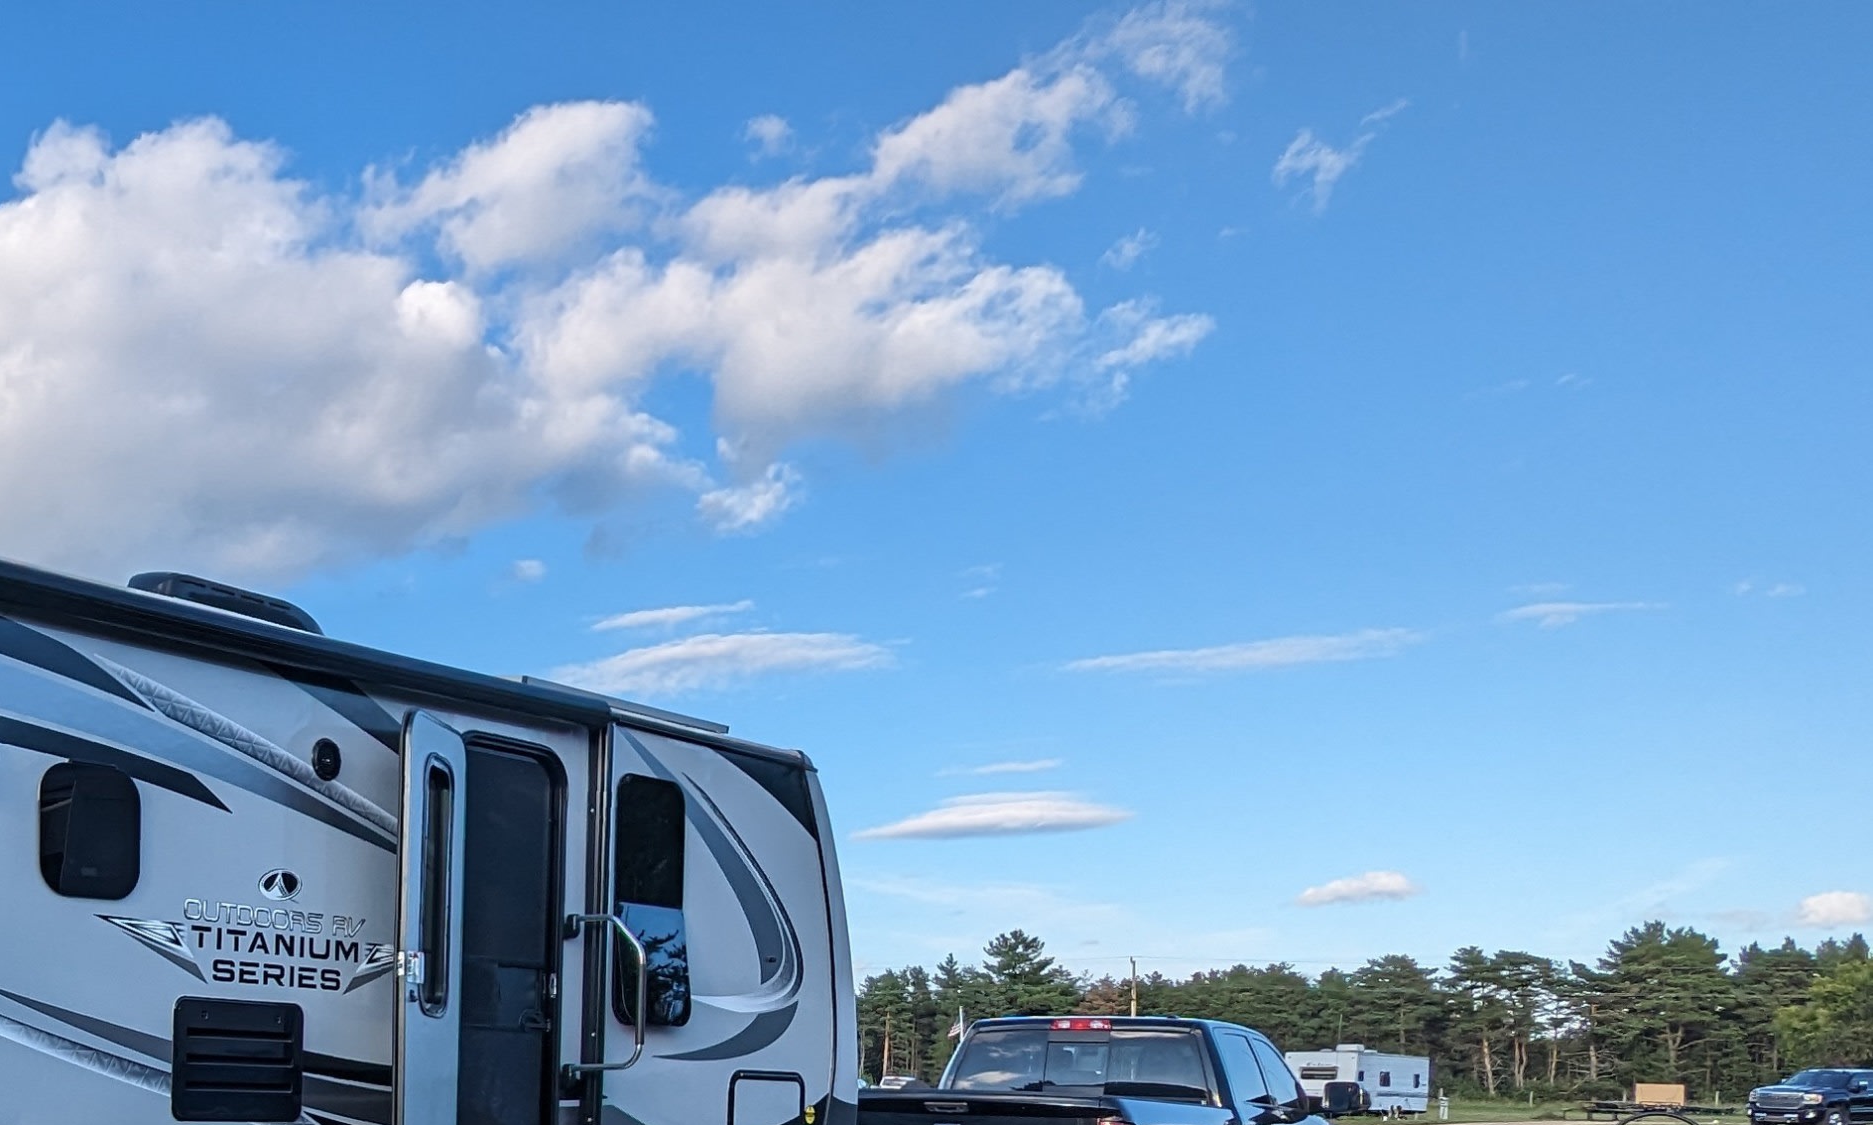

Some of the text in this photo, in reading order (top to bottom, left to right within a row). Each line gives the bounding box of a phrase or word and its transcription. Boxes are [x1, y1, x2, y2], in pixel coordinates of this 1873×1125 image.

[183, 898, 366, 938] OUTDOORS RV
[191, 925, 359, 963] TITANIUM
[212, 959, 341, 991] SERIES
